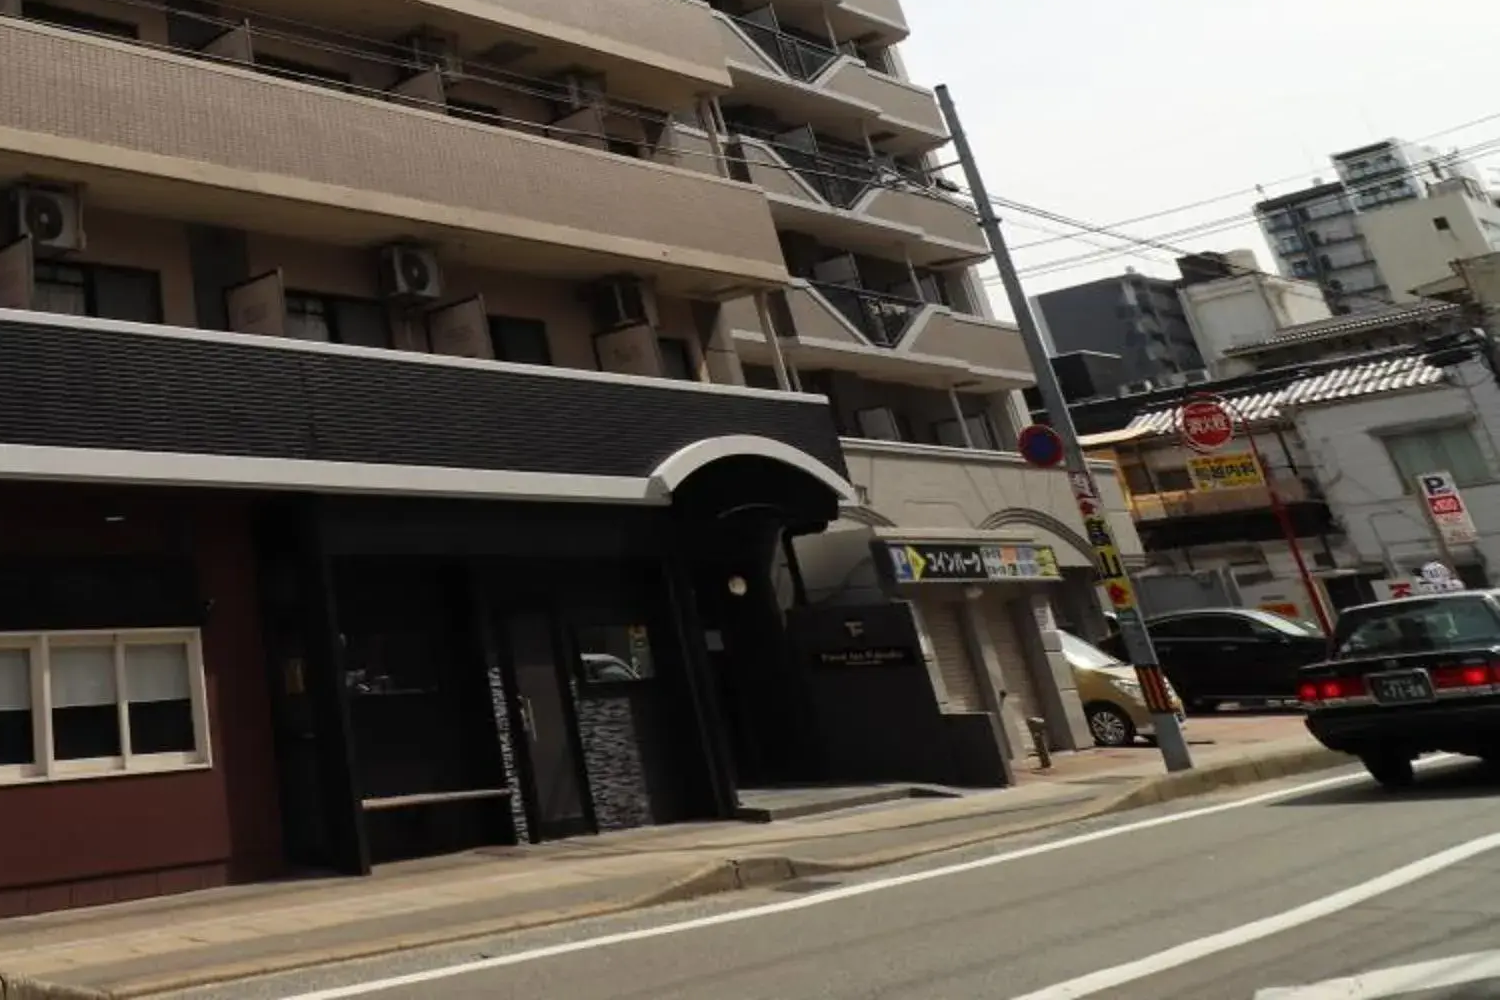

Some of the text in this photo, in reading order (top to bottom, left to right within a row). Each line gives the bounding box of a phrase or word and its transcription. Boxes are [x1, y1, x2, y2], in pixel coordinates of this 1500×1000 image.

[926, 552, 981, 573] コインパーク
